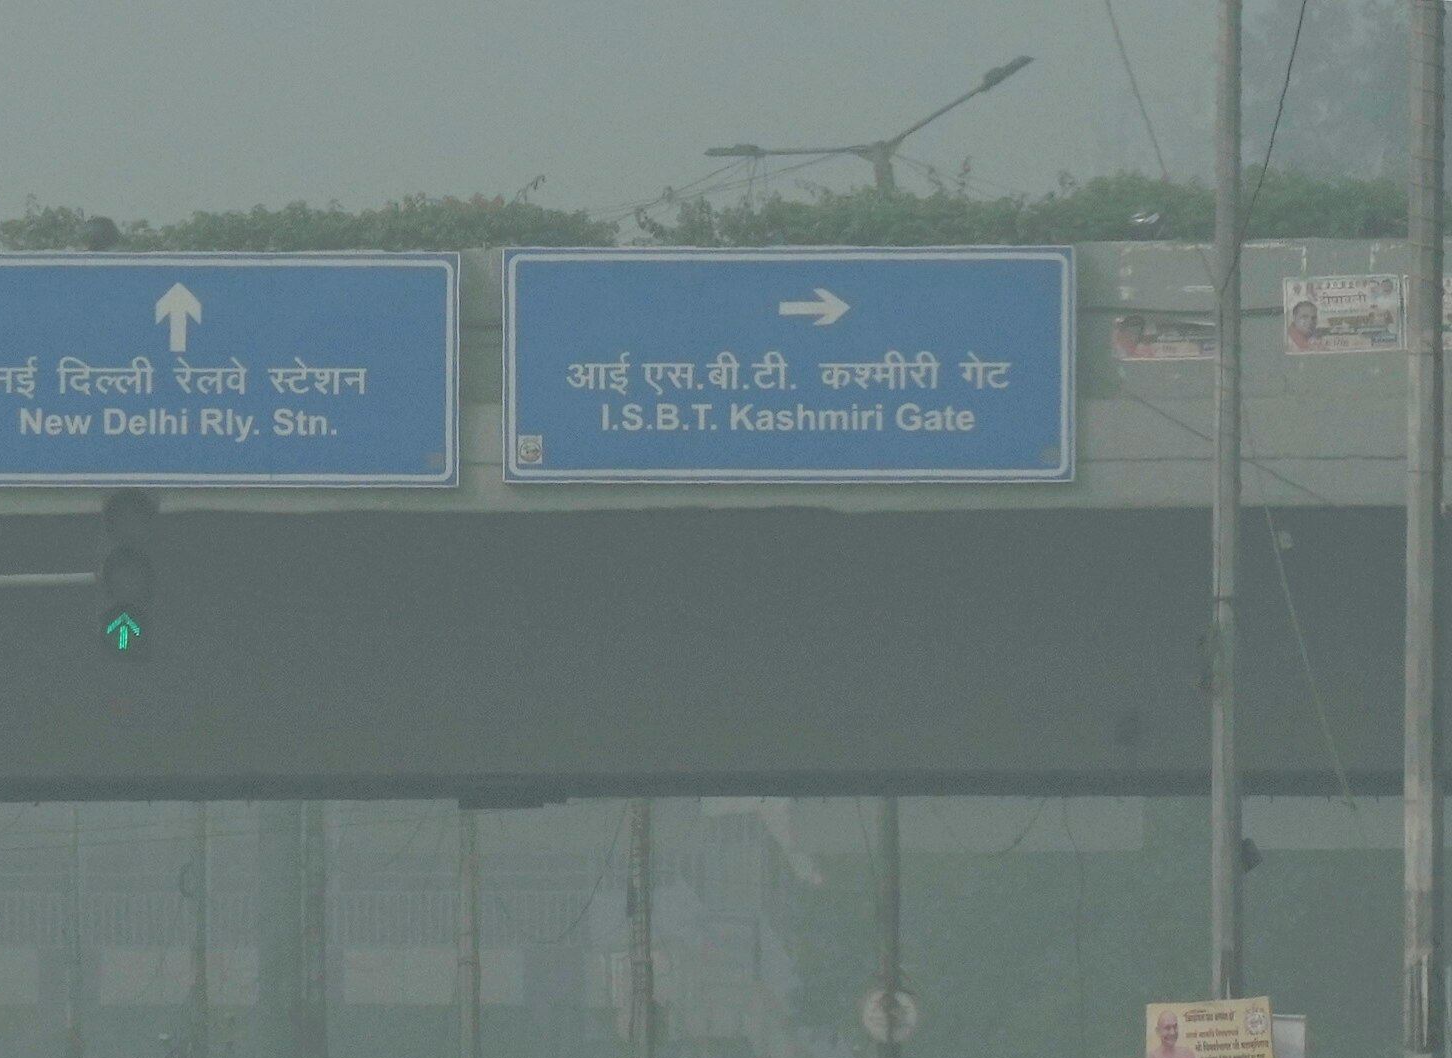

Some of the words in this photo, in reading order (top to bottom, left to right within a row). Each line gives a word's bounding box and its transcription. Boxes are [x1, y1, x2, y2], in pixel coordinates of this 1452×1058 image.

[57, 356, 155, 396] दिल्ली
[173, 356, 248, 396] रेलवे
[268, 356, 368, 396] स्टेशन
[566, 352, 630, 396] आई
[819, 350, 940, 391] कश्मीरी
[958, 351, 1012, 390] गेट
[19, 409, 93, 436] New
[103, 408, 188, 436] Delhi
[200, 408, 262, 443] Rly.
[272, 408, 339, 436] Stn.
[601, 404, 719, 432] I.S.B.T.
[729, 404, 884, 432] Kashmiri
[895, 403, 976, 431] Gate
